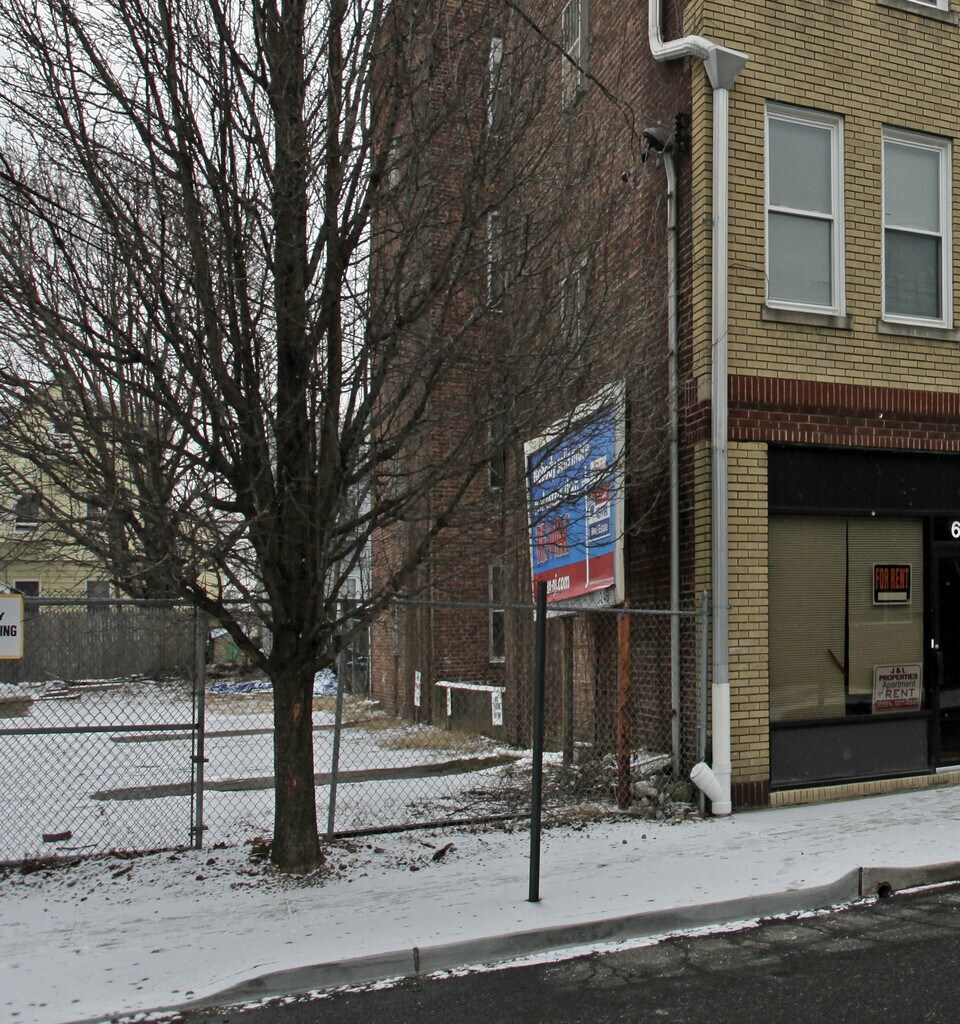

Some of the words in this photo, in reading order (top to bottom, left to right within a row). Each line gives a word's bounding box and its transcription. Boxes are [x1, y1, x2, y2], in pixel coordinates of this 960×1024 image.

[876, 568, 889, 590] FOR
[890, 568, 910, 590] RENT
[879, 674, 918, 682] PROPERTIES
[882, 680, 916, 689] Apartment
[885, 688, 915, 699] RENT
